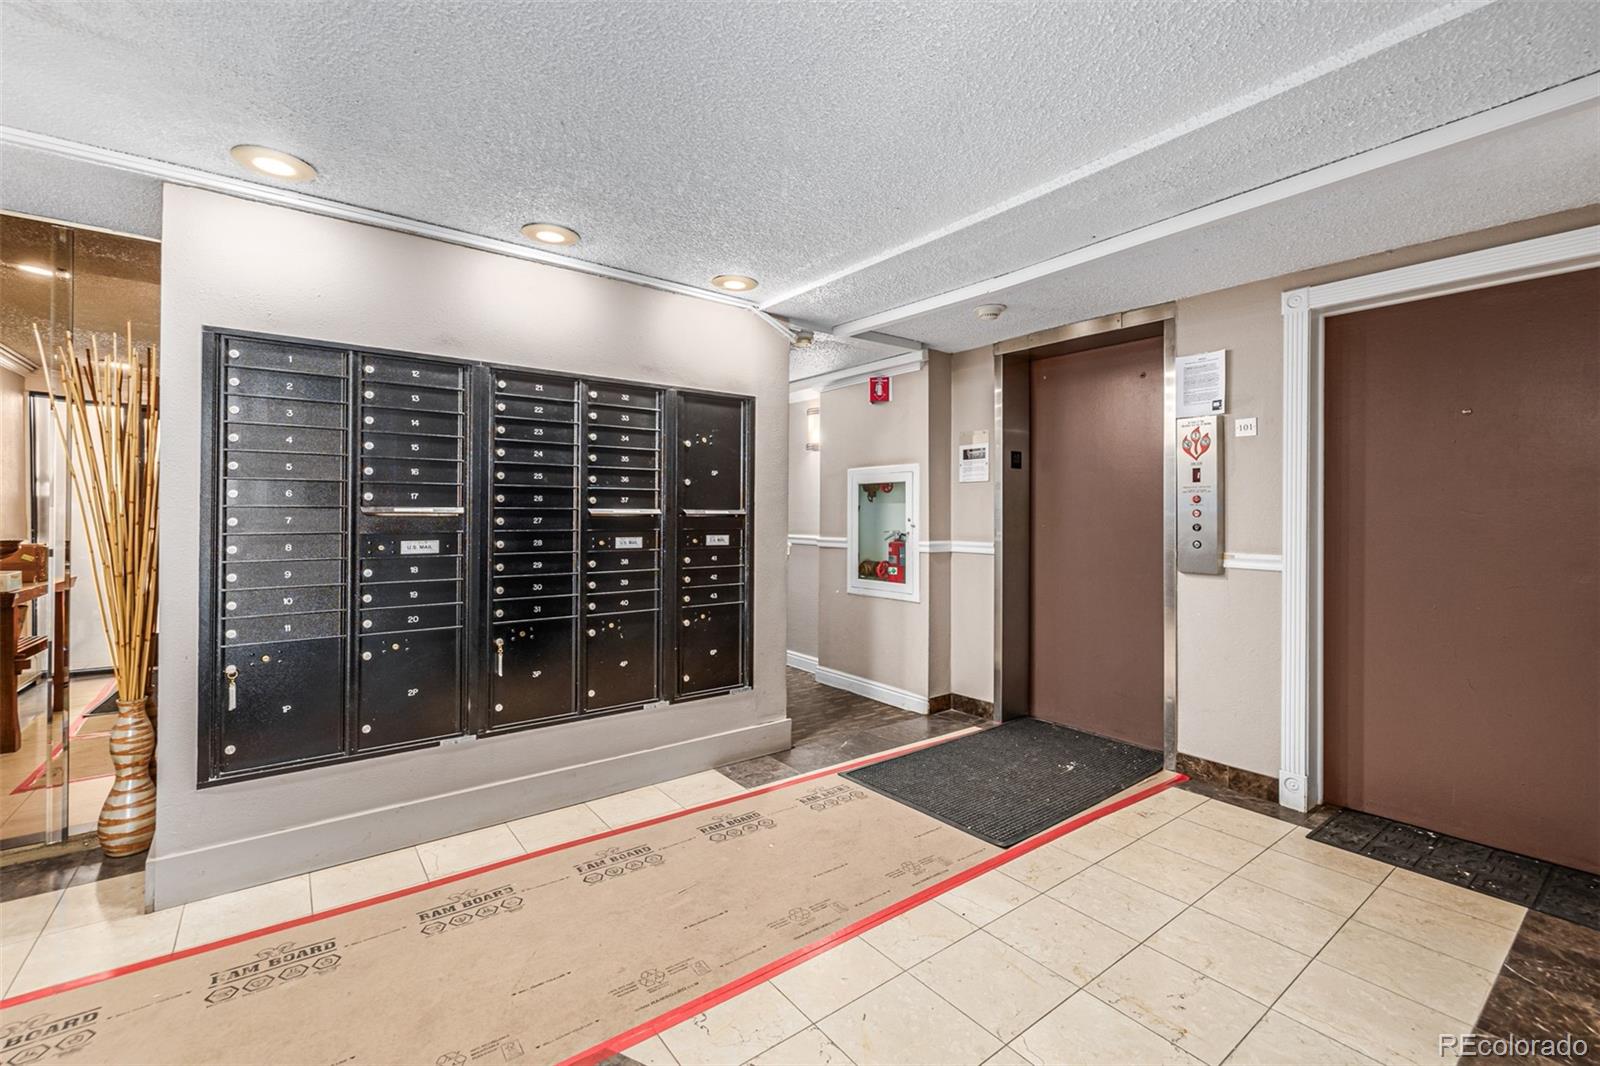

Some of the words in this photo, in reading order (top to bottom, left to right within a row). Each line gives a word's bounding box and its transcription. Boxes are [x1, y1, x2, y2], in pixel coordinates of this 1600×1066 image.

[288, 355, 293, 363] 1
[411, 370, 420, 378] 12
[286, 382, 294, 391] 2
[411, 394, 420, 402] 13
[286, 409, 294, 417] 3
[410, 419, 420, 427] 14
[1239, 423, 1253, 432] 101
[285, 436, 293, 444] 4
[410, 443, 420, 452] 15
[285, 462, 293, 471] 5
[410, 468, 420, 476] 16
[285, 489, 293, 498] 6
[410, 492, 419, 500] 17
[285, 516, 292, 524] 7
[284, 543, 293, 552] 8
[409, 565, 419, 574] 18
[283, 570, 292, 579] 9
[409, 590, 418, 599] 19
[282, 597, 294, 606] 10
[407, 615, 420, 624] 20
[284, 624, 292, 632] 11
[407, 688, 419, 697] 2P
[282, 704, 292, 714] 1P
[699, 823, 725, 834] RAM
[726, 811, 761, 826] BOARD
[609, 845, 652, 863] BOARD
[419, 904, 457, 921] RAM
[268, 940, 336, 967] BOARD
[3, 1011, 98, 1049] BOARD
